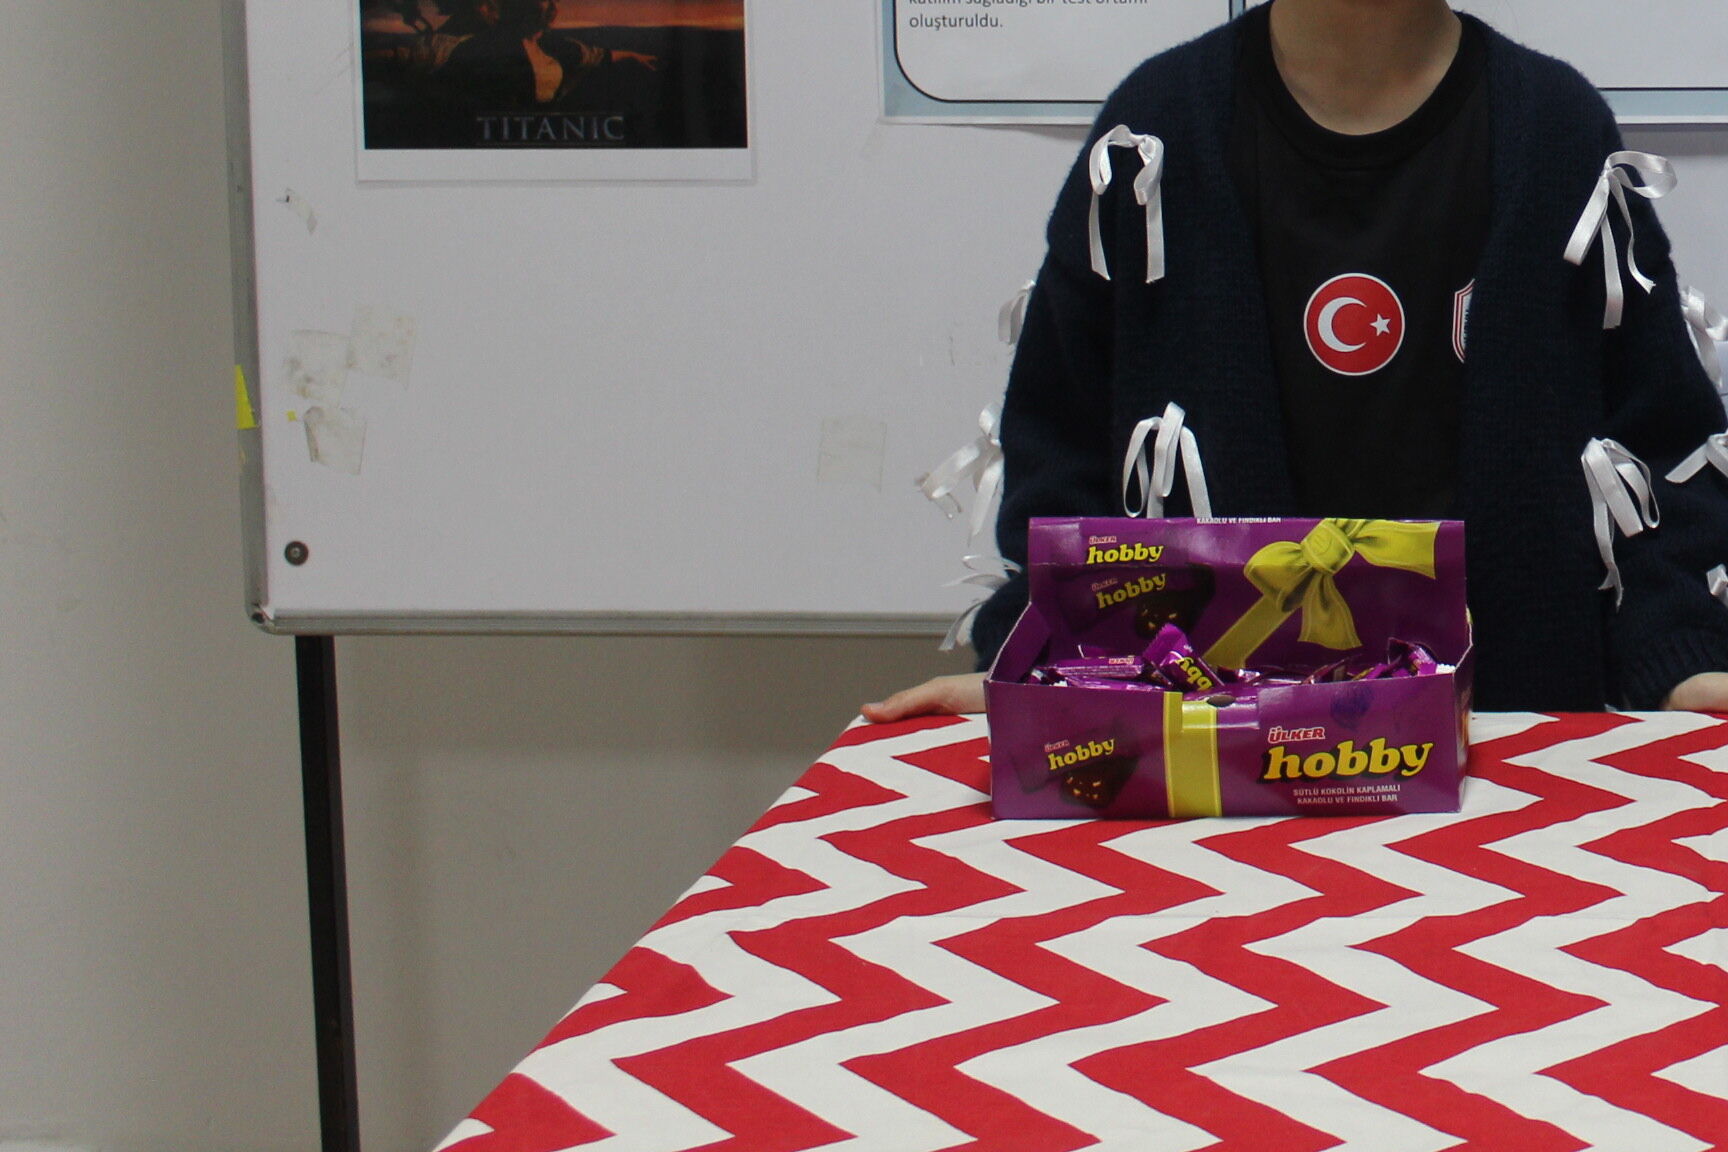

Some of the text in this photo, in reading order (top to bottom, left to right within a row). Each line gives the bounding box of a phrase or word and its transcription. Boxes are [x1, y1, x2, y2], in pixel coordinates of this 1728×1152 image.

[476, 115, 625, 141] TITANIC
[1086, 543, 1164, 565] hobby
[1096, 573, 1167, 609] hobby
[1268, 726, 1326, 743] ÜLKER
[1048, 738, 1115, 770] hobby
[1263, 737, 1434, 781] hobby
